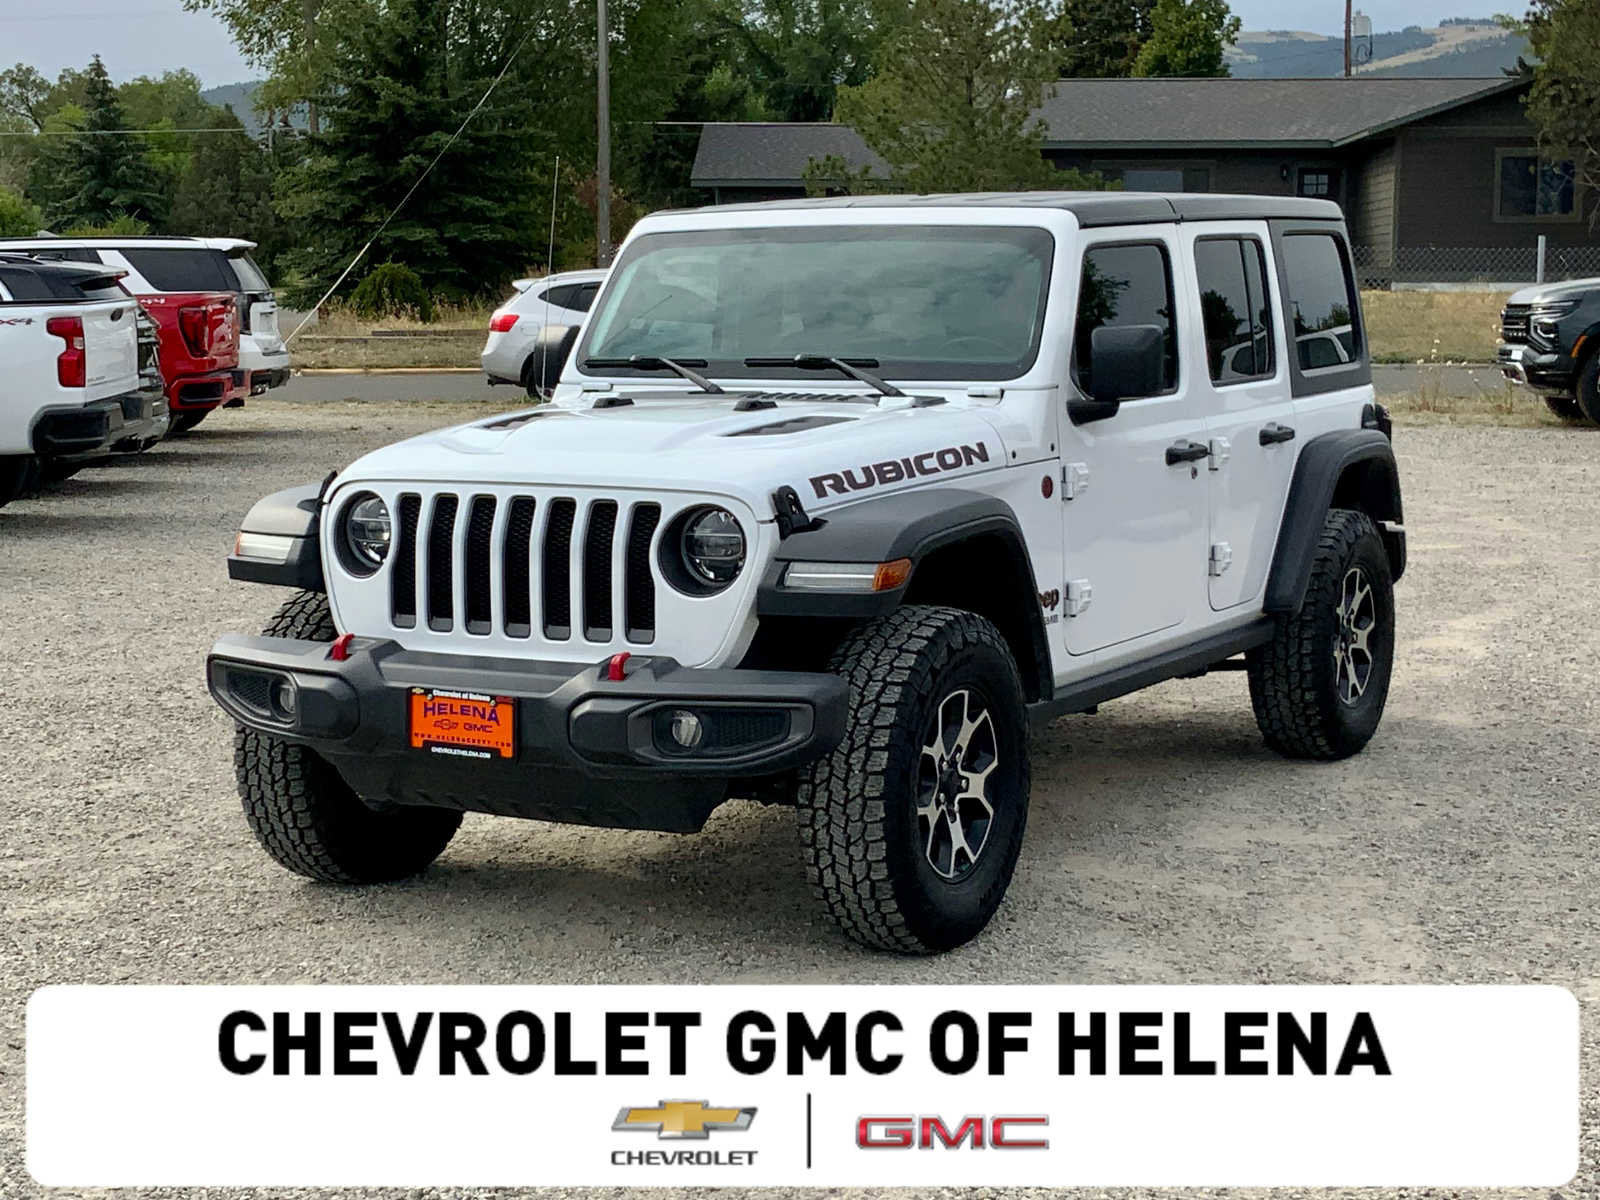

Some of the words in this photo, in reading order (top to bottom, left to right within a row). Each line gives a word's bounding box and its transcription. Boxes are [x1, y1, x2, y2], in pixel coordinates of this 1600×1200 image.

[808, 442, 990, 499] RUBICON
[423, 701, 500, 726] HELENA
[463, 722, 494, 734] GMC
